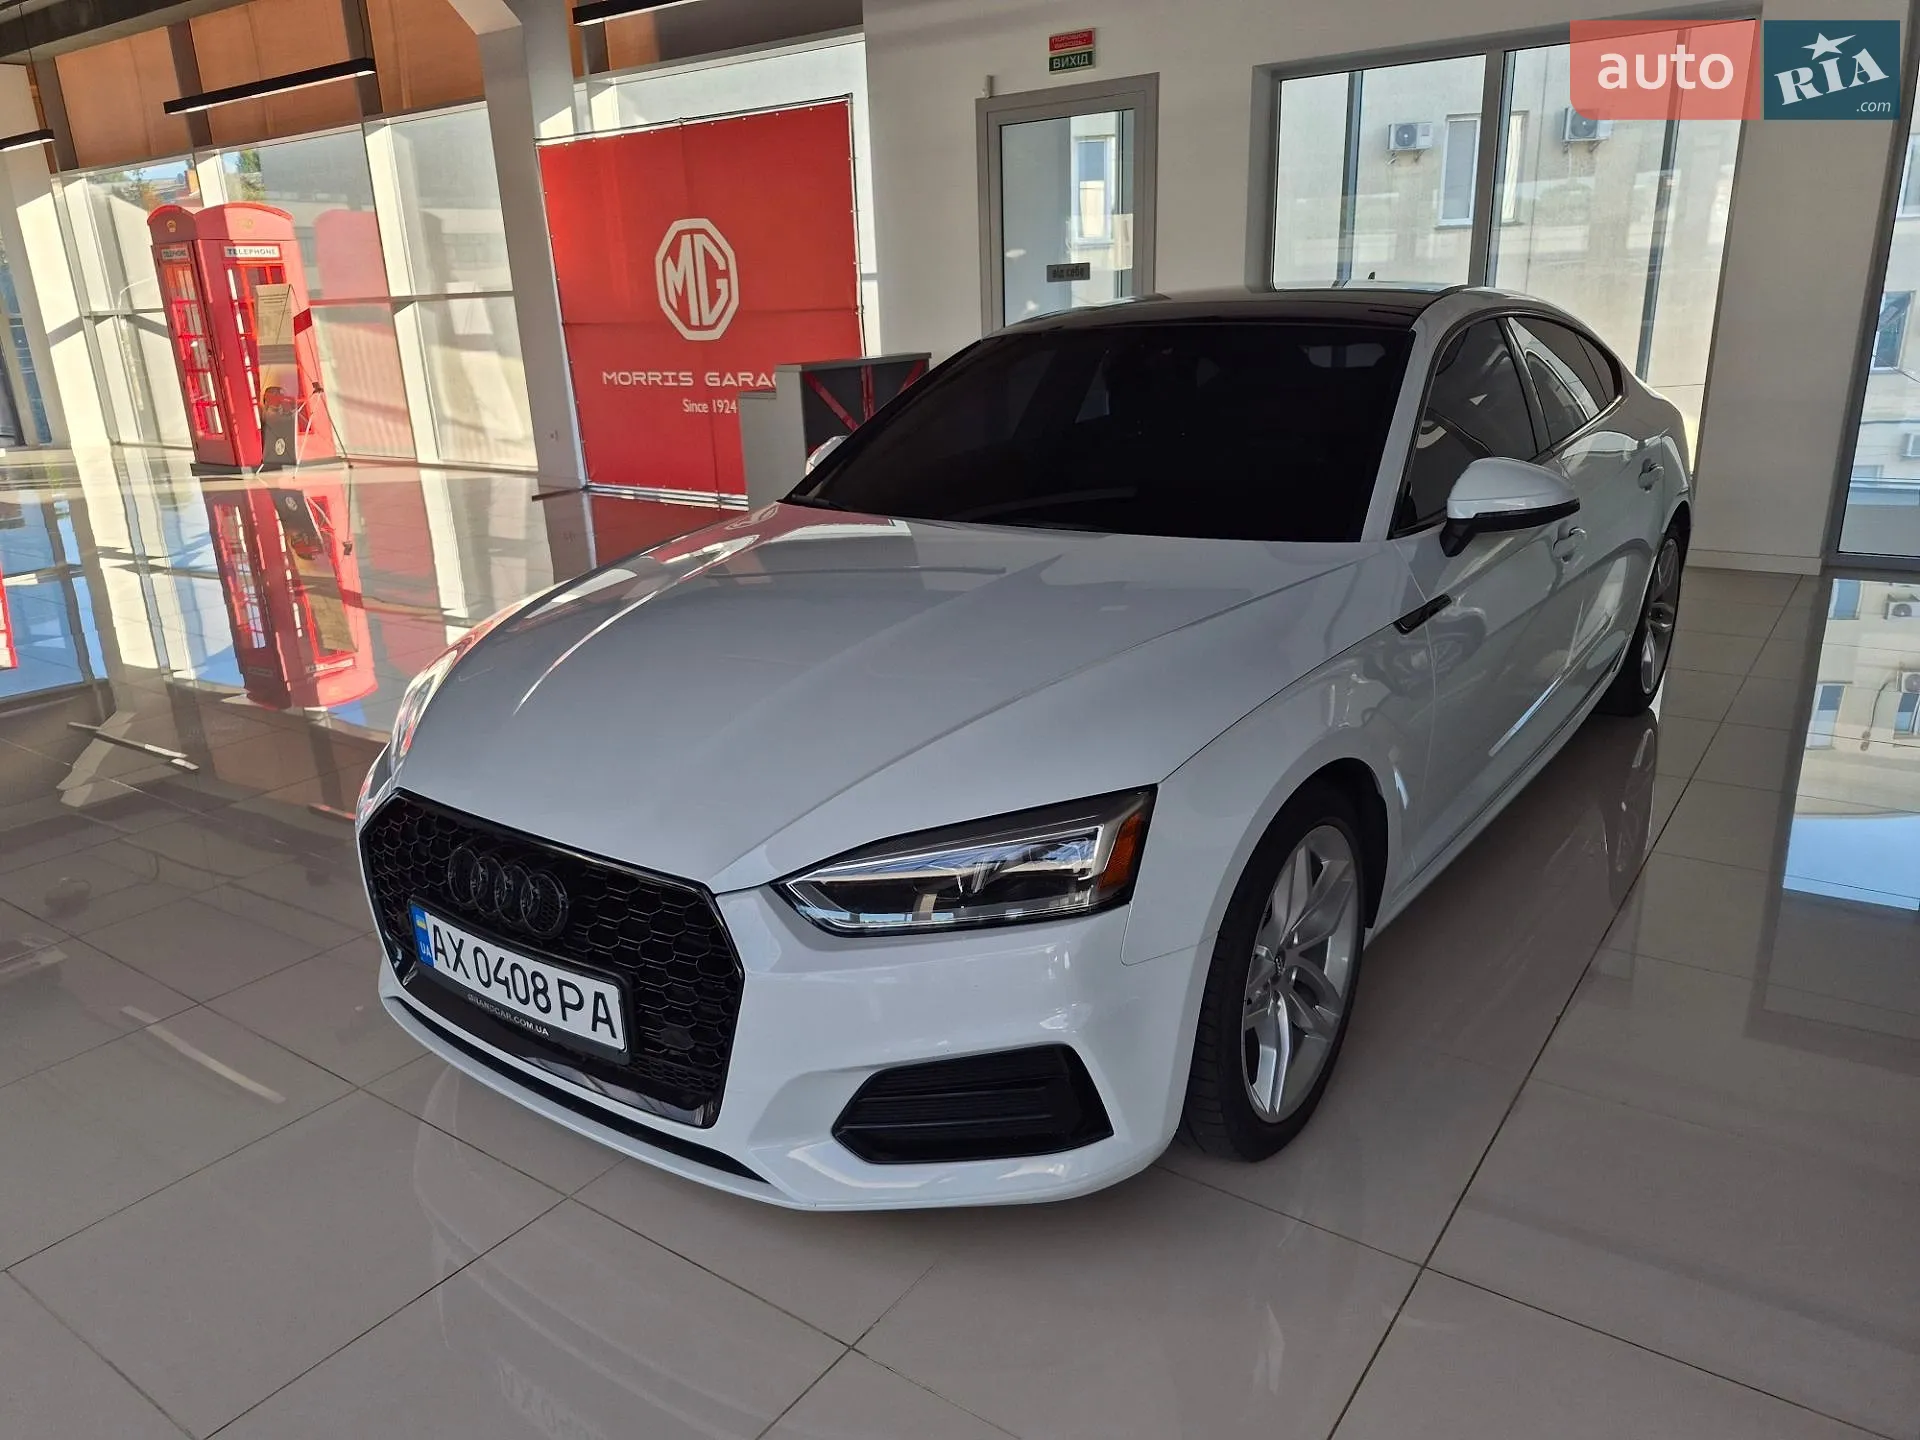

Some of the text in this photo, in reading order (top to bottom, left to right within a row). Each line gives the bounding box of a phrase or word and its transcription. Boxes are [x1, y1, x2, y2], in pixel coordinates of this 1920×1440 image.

[1053, 53, 1089, 69] ВИХІД
[227, 248, 276, 256] TELEPHONE
[665, 233, 729, 326] MG
[602, 371, 694, 387] MORRIS
[682, 398, 737, 415] Since 1924
[419, 942, 432, 958] UA
[432, 924, 617, 1039] AX 0408 PA
